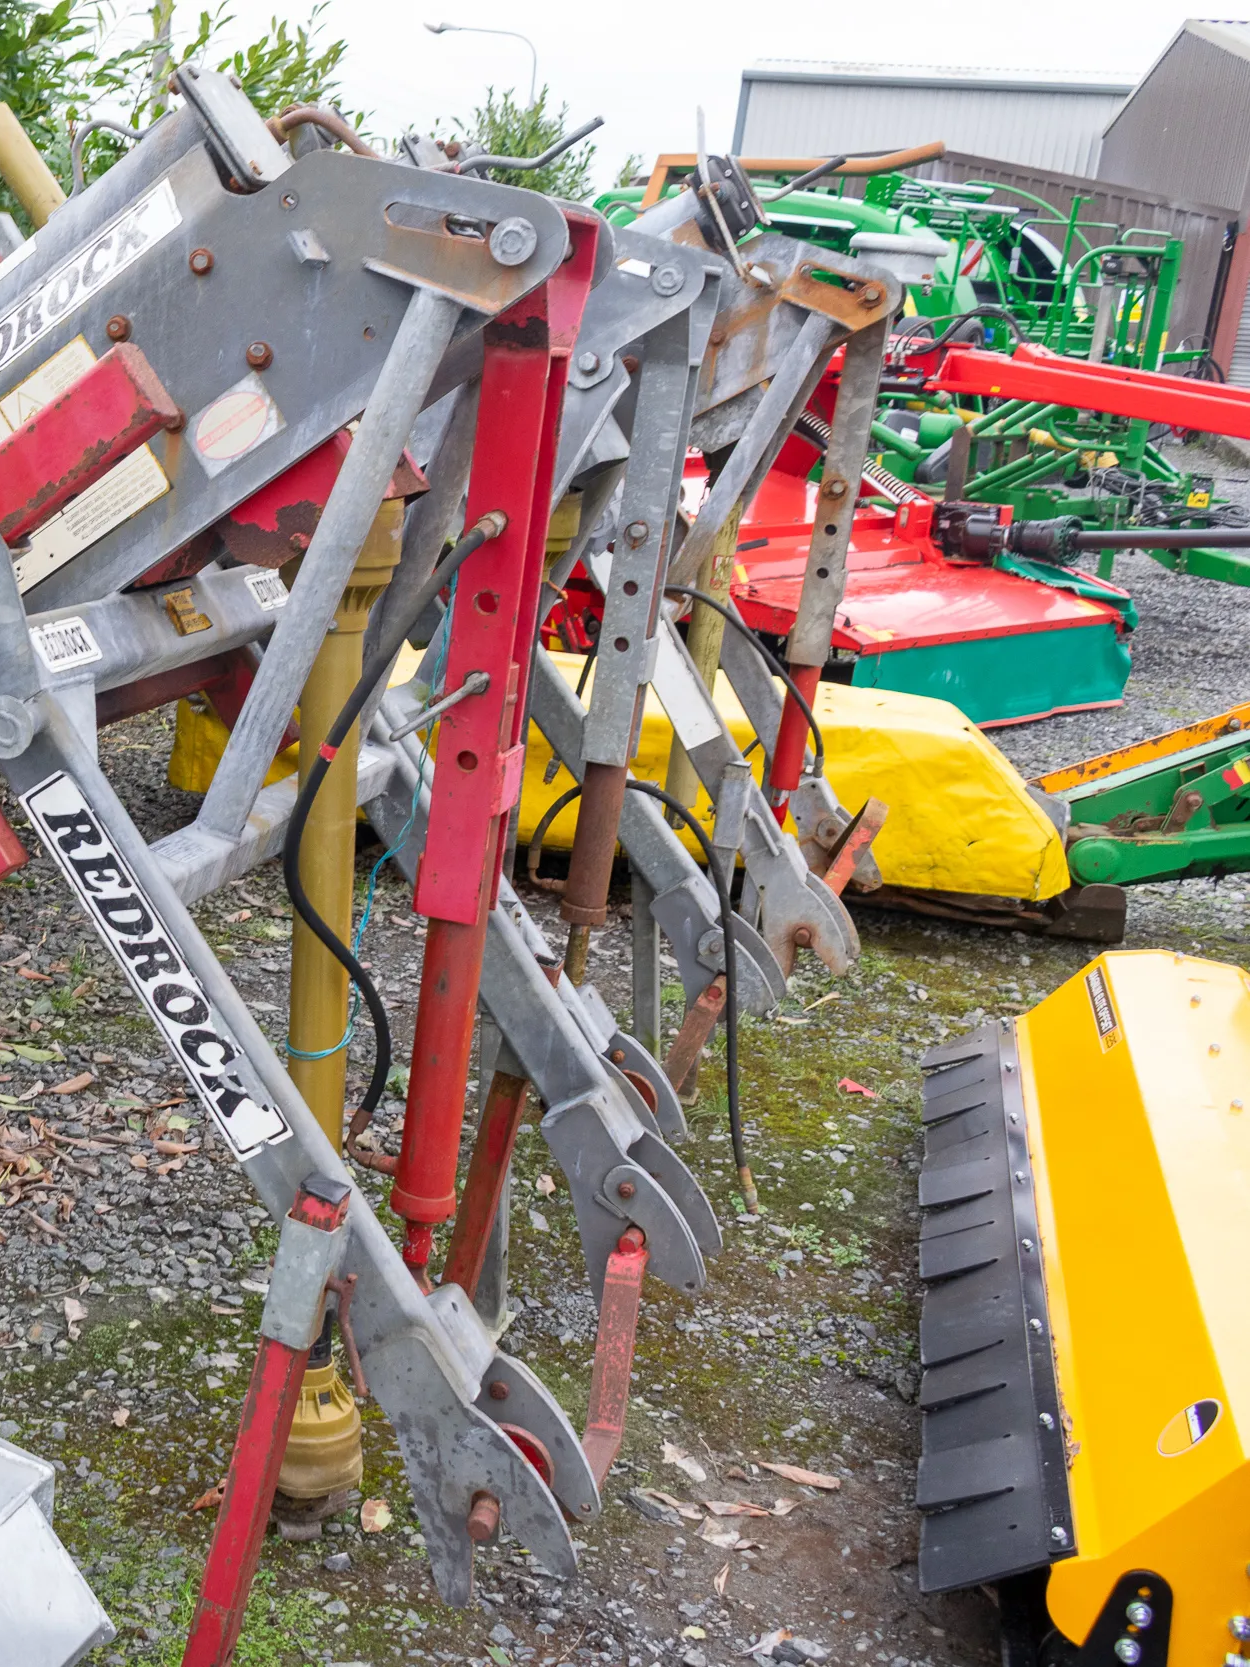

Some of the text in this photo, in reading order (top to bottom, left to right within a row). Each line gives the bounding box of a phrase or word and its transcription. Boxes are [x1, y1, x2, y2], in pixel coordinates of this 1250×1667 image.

[42, 808, 270, 1117] REDROCK
[1094, 992, 1108, 1012] ELITE
[1098, 1006, 1113, 1032] OFFSET
